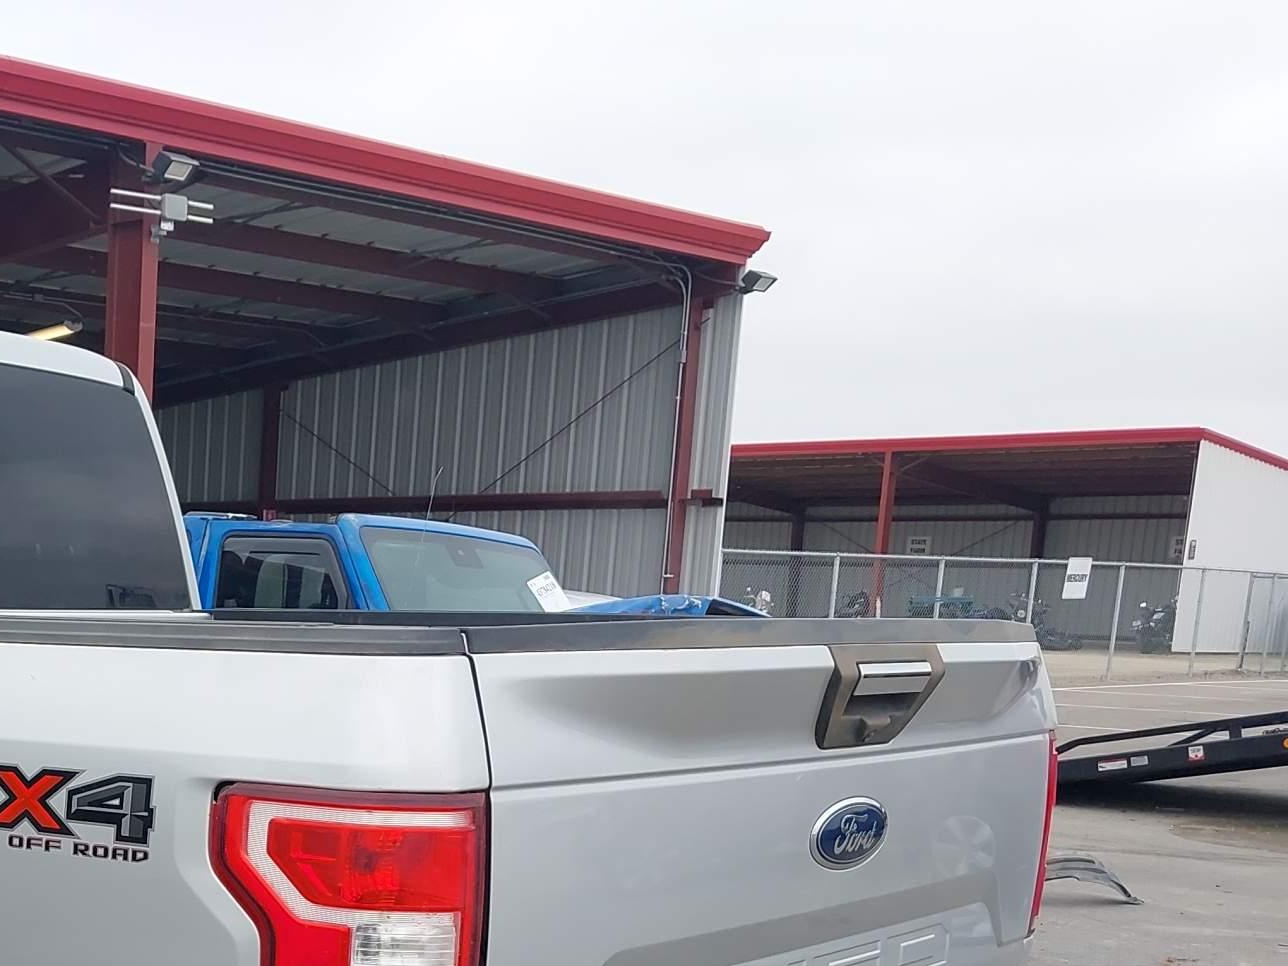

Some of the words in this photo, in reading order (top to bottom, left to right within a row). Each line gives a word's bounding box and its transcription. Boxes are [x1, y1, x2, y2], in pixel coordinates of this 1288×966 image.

[8, 833, 62, 852] OFF
[72, 841, 149, 863] ROAD
[833, 813, 878, 855] Ford
